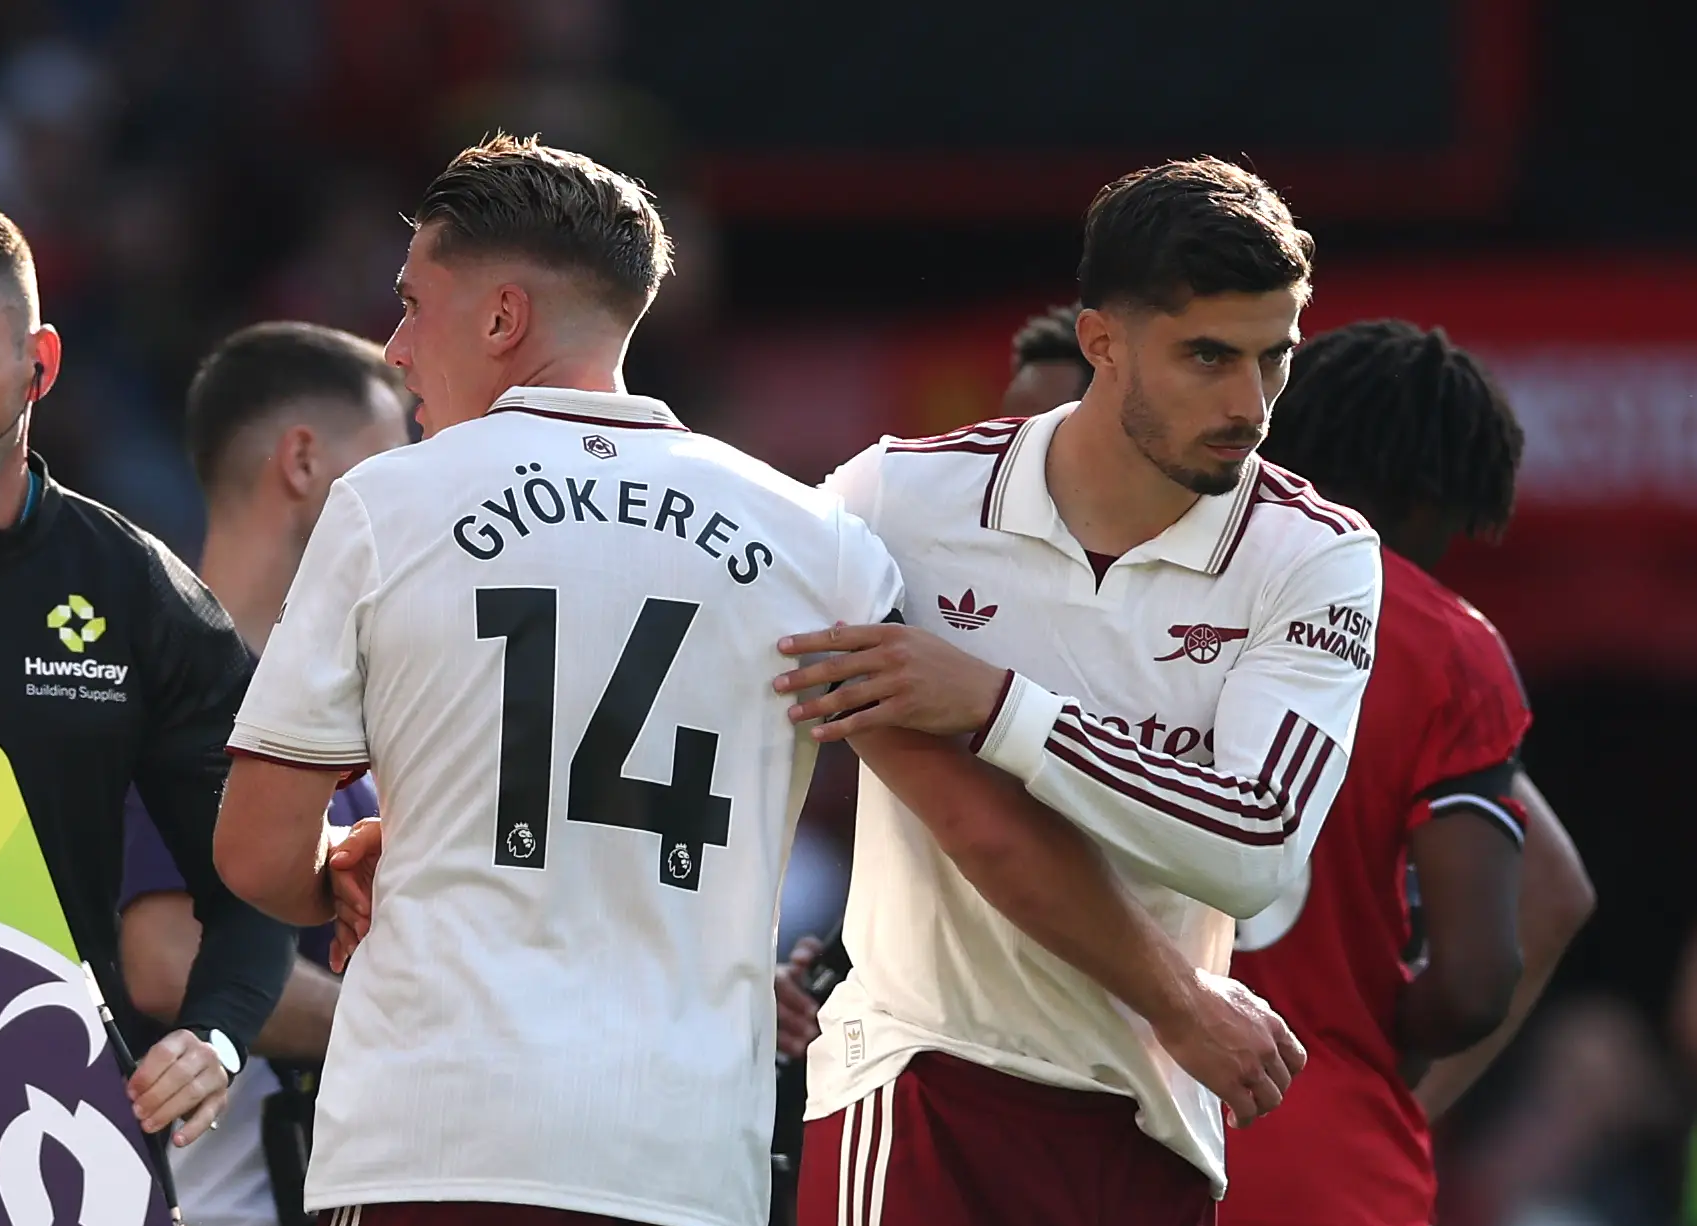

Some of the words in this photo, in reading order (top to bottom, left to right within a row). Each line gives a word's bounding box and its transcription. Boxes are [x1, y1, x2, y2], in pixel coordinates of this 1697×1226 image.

[453, 462, 774, 585] GYÖKERES
[1328, 603, 1372, 643] VISIT
[25, 656, 129, 685] HuwsGray
[25, 683, 77, 700] Building
[78, 686, 127, 702] Supplies
[473, 586, 733, 892] 14
